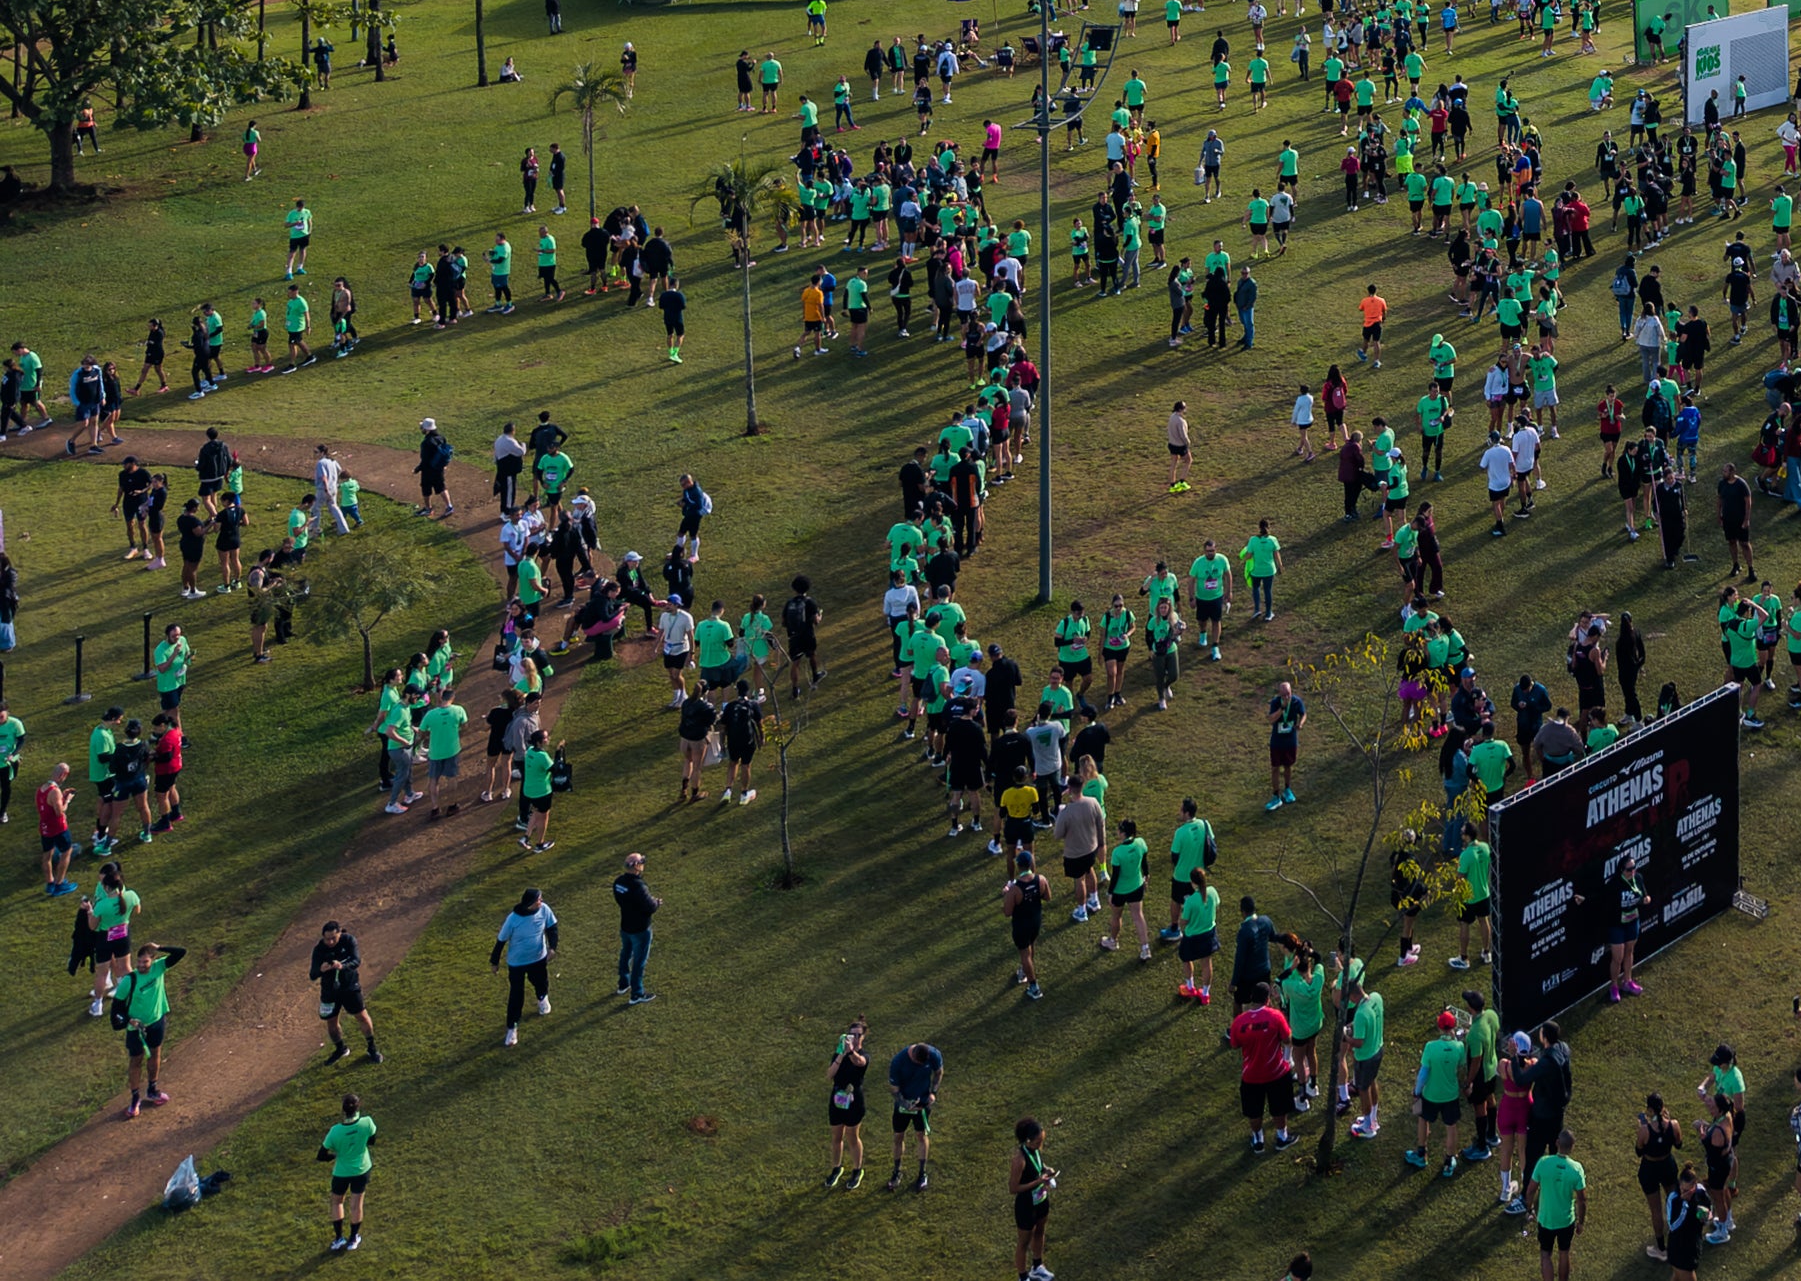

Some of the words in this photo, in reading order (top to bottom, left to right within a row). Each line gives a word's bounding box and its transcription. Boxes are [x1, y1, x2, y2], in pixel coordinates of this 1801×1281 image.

[1695, 52, 1721, 76] KIDS
[1586, 764, 1664, 829] ATHENAS
[1588, 774, 1618, 794] CIRCUITO
[1676, 797, 1722, 838] ATHENAS
[1694, 817, 1717, 836] LONGER
[1603, 837, 1651, 879] ATNAS
[1522, 881, 1574, 925] ATHENAS
[1529, 919, 1543, 932] RUN
[1543, 904, 1567, 923] FASTER
